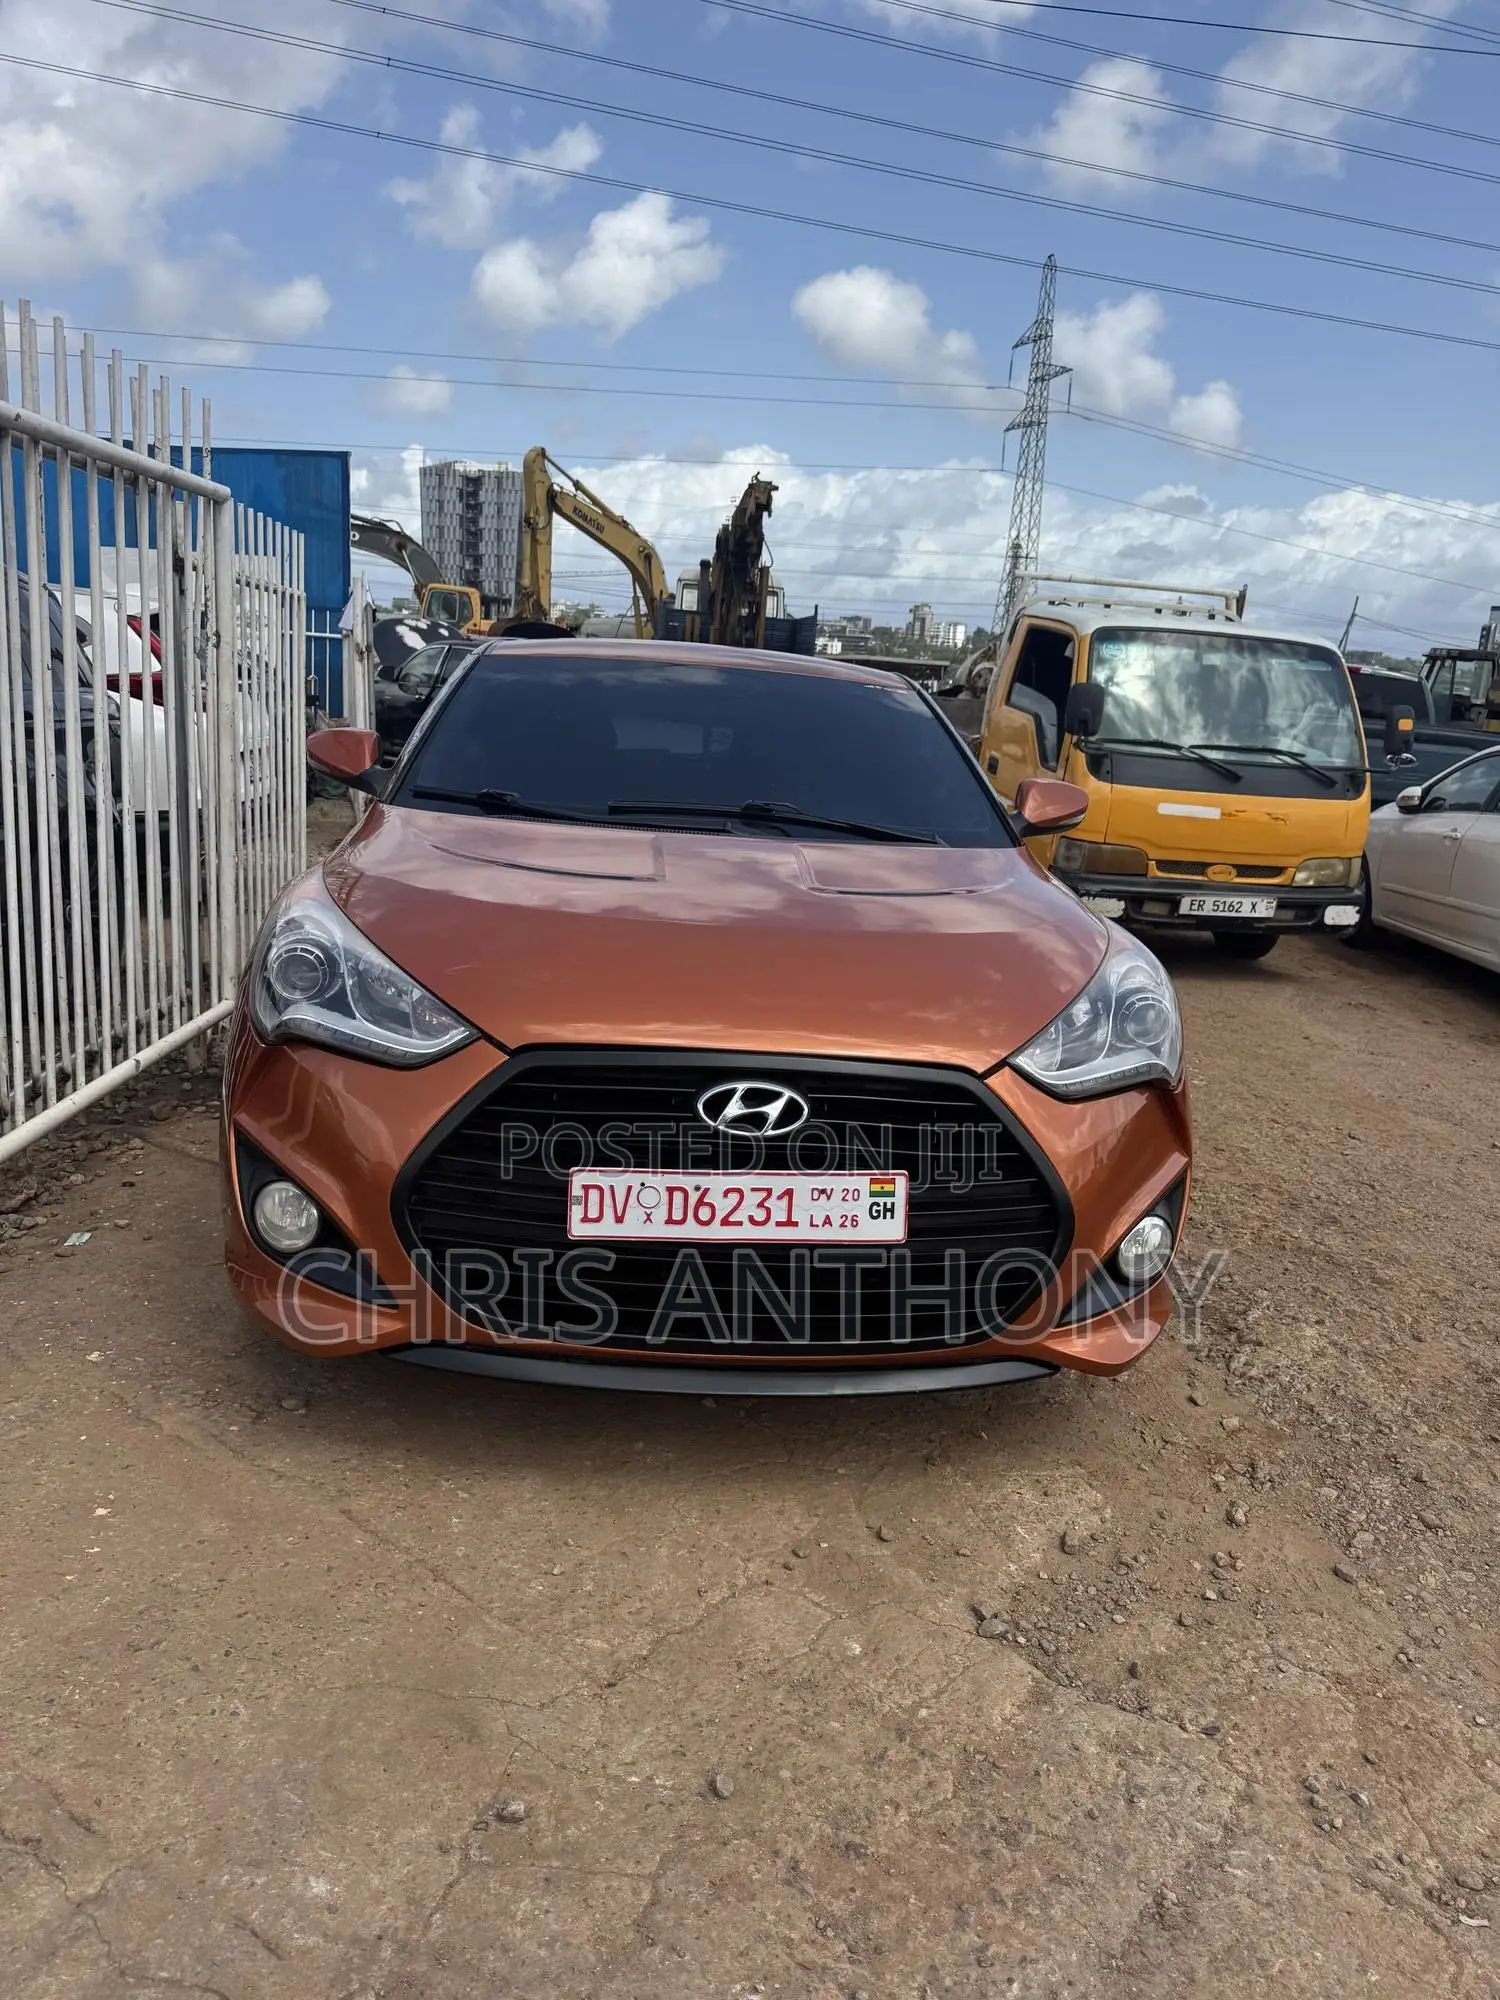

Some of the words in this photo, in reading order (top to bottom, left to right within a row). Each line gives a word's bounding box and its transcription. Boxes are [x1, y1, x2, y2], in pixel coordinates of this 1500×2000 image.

[572, 504, 605, 534] KOMATSU
[1189, 899, 1206, 912] ER
[1212, 900, 1243, 913] 5162
[1249, 901, 1258, 913] X
[841, 1188, 861, 1201] 20
[580, 1183, 633, 1224] DV
[664, 1185, 799, 1227] D6231
[868, 1201, 895, 1220] GH
[809, 1213, 833, 1227] LA
[839, 1214, 859, 1227] 26
